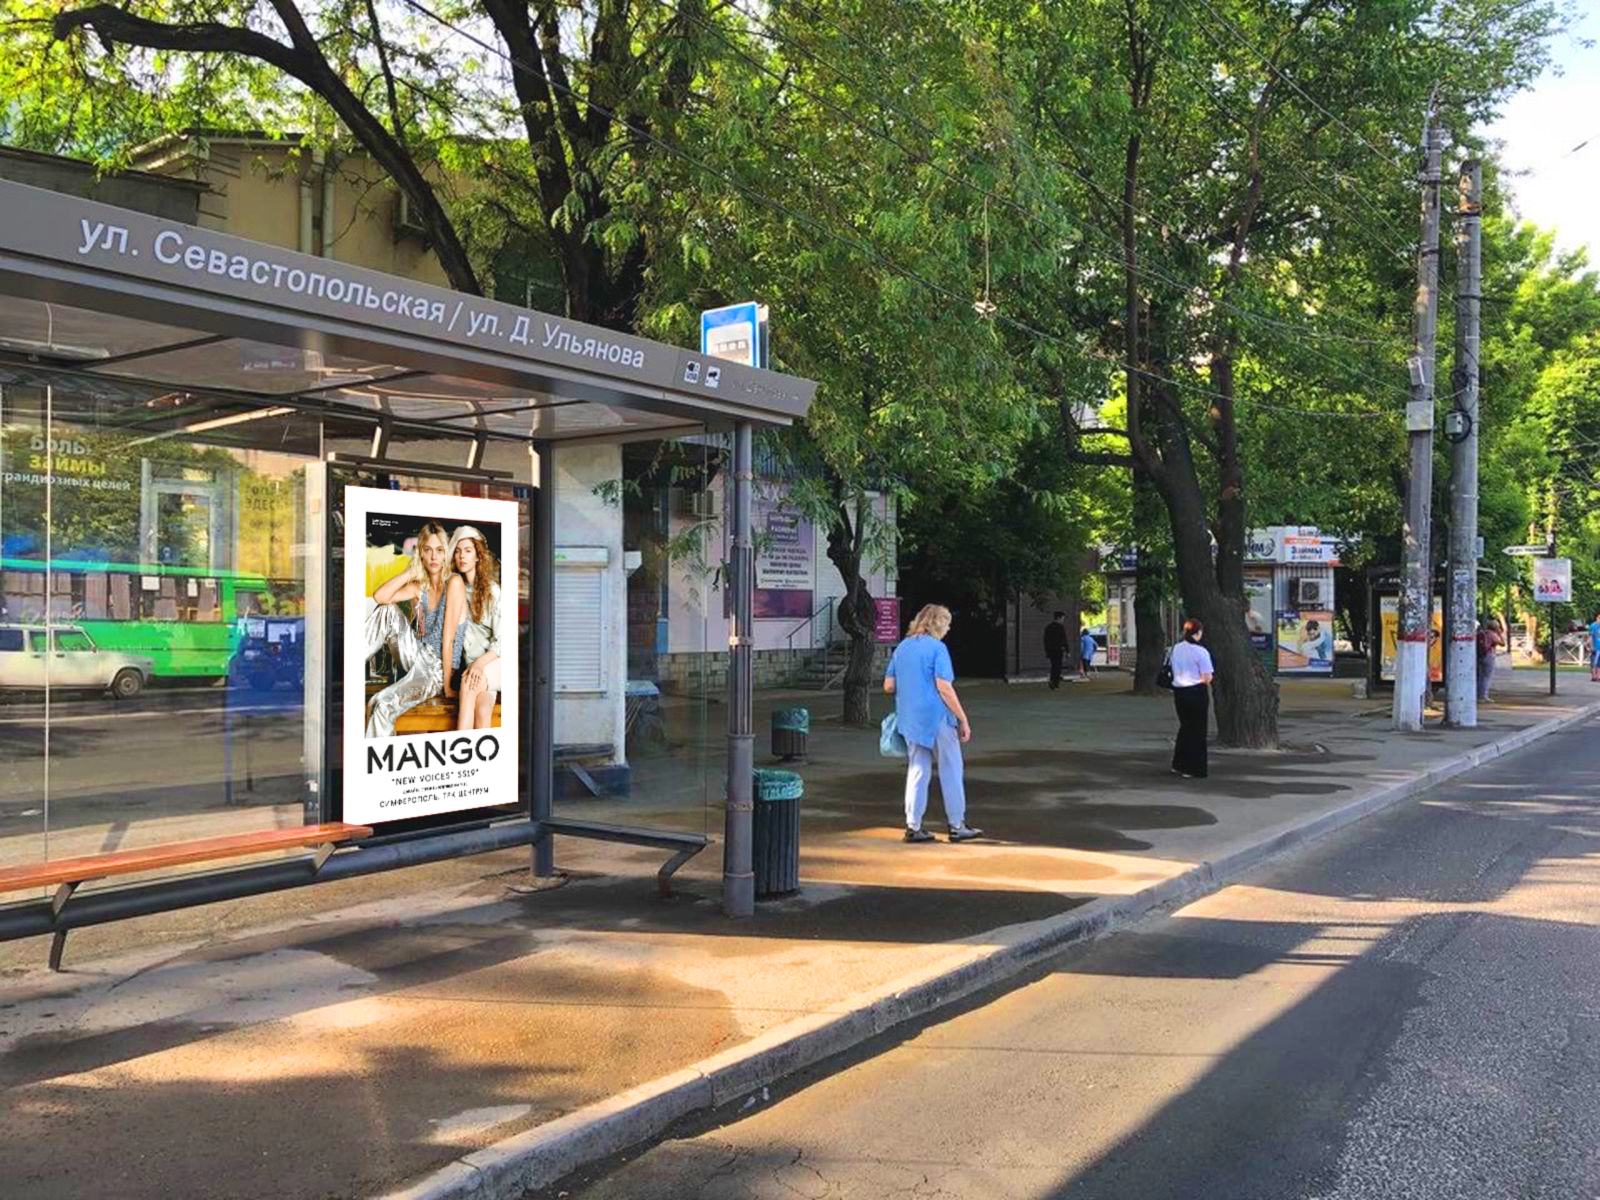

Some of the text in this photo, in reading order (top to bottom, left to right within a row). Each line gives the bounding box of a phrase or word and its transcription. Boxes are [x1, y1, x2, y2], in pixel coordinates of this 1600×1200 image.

[78, 218, 645, 369] ул. Севастопольская / ул. Д. Ульянова
[367, 734, 500, 775] MANGO
